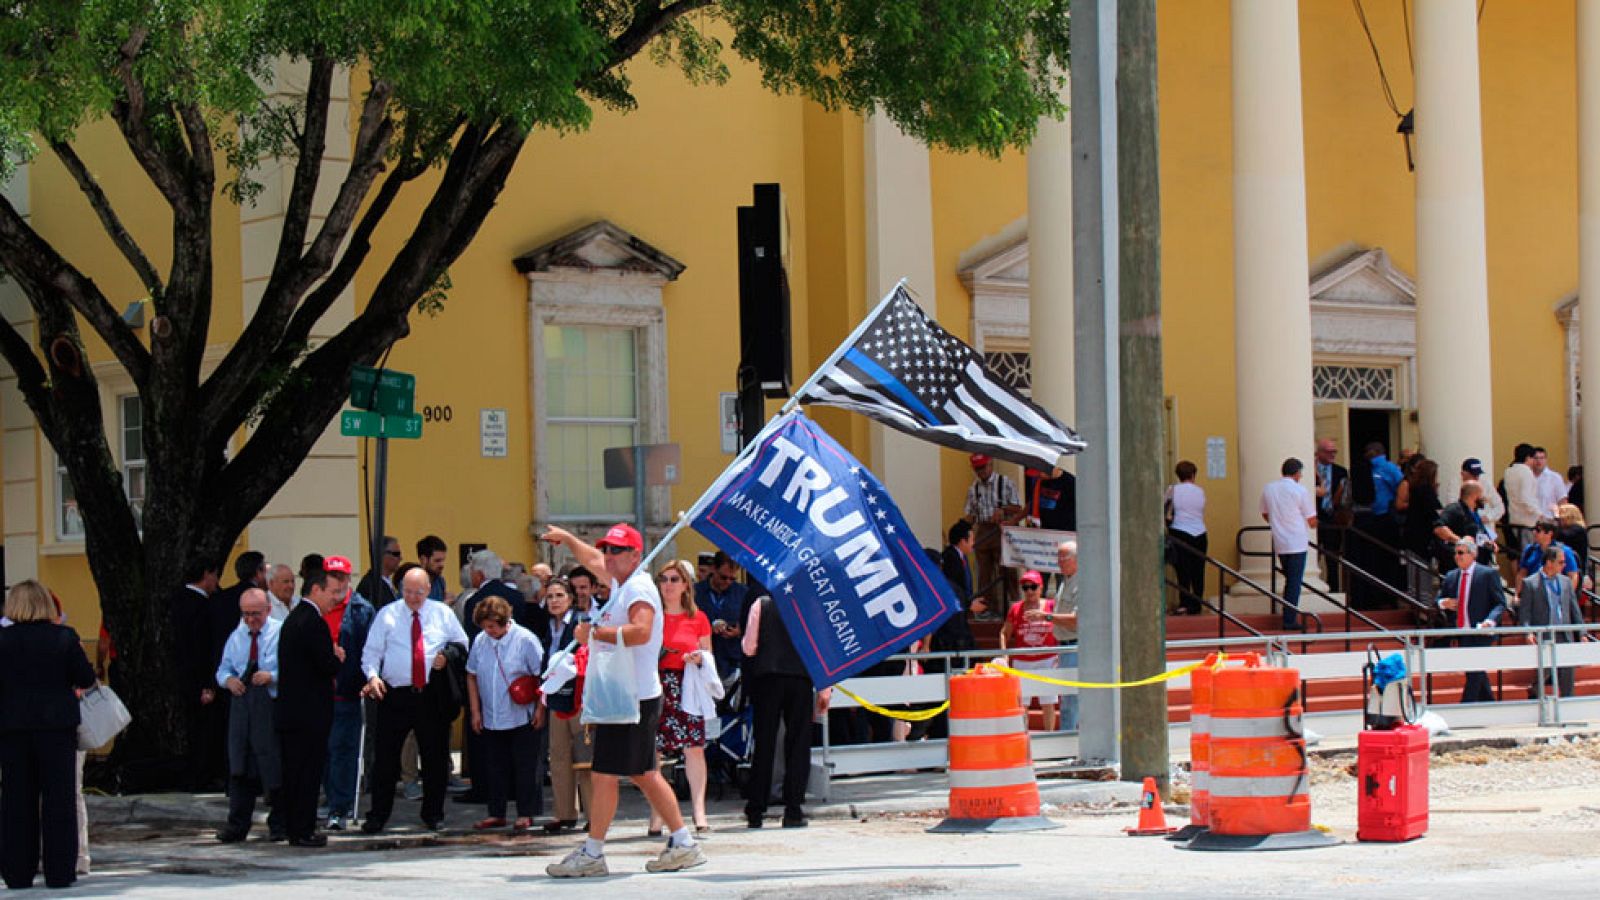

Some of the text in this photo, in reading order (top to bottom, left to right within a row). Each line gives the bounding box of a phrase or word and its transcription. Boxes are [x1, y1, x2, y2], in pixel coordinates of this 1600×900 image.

[345, 418, 361, 429] SW
[405, 419, 419, 432] ST
[423, 406, 452, 422] 900
[728, 490, 862, 657] MAKE AMERICA GREAT AGAIN!
[758, 435, 918, 628] TRUMP
